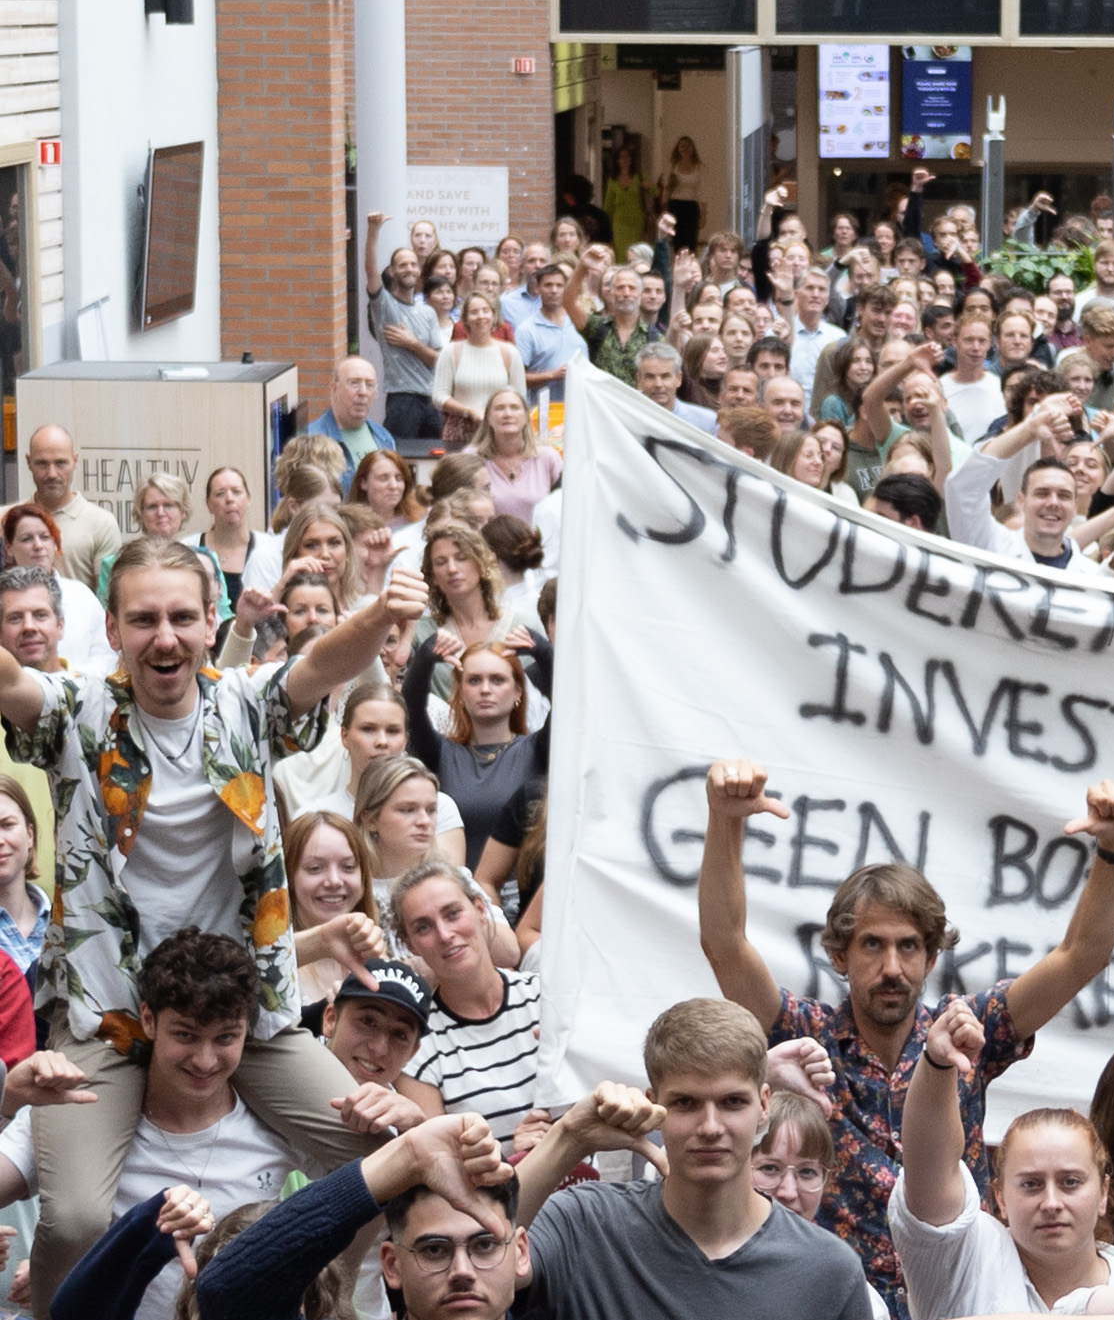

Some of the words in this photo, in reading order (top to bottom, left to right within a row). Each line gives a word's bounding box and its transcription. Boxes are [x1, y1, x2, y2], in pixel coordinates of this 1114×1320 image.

[407, 190, 434, 200] AND
[438, 190, 470, 201] SAVE
[407, 206, 453, 216] MONEY
[457, 206, 490, 217] WITH
[439, 222, 468, 232] NEW
[471, 222, 500, 233] APP!
